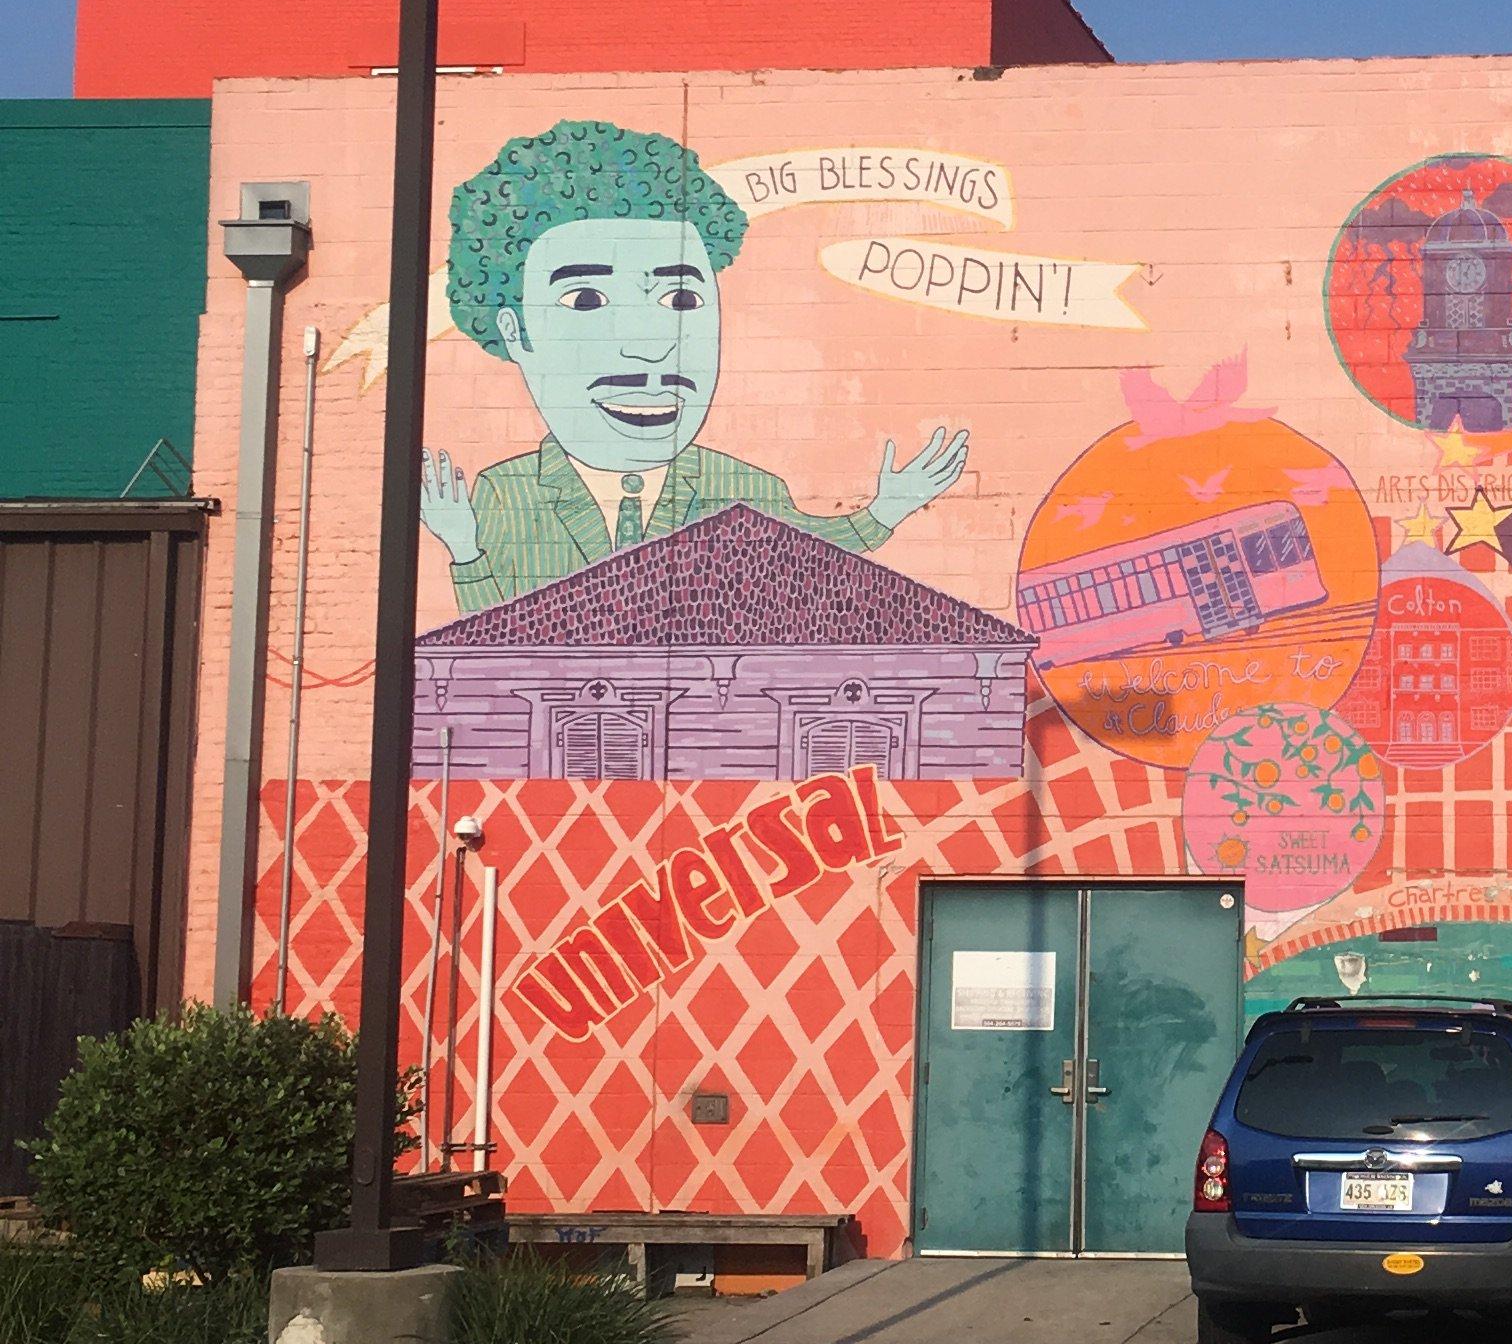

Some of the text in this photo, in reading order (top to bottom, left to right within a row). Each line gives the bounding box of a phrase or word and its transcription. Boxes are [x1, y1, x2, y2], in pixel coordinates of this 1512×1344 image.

[745, 155, 998, 210] BIG BLESSINGS
[858, 240, 1072, 316] POPPIN'!
[1376, 475, 1430, 504] ARTS
[1387, 585, 1462, 615] Colton
[1079, 645, 1341, 703] Welcome to
[1279, 830, 1329, 850] SWEET
[1256, 853, 1350, 876] SATSUMA
[1345, 1183, 1372, 1200] 435
